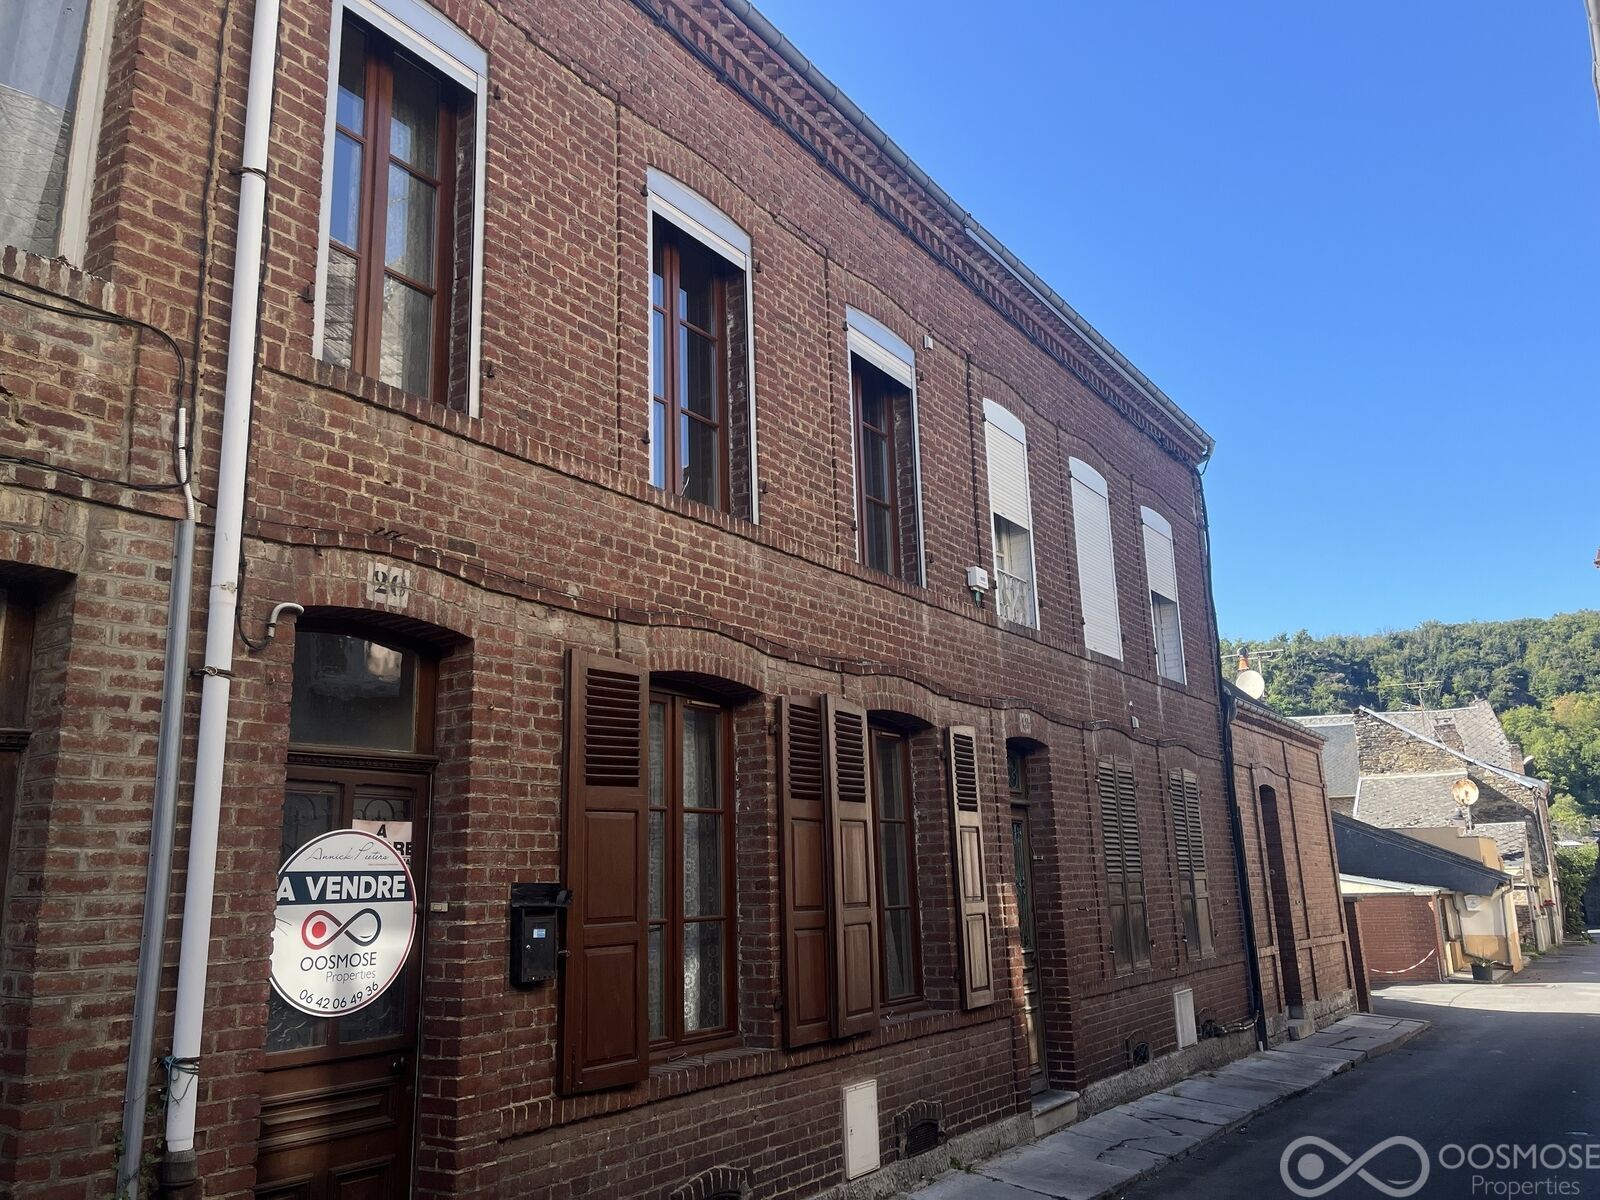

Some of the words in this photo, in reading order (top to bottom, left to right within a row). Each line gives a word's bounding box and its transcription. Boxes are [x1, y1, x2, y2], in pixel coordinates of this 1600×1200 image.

[376, 824, 388, 839] A
[305, 847, 353, 861] Annick
[276, 876, 296, 902] A
[305, 875, 406, 901] VENDRE
[300, 952, 377, 971] OOSMOSE
[326, 970, 376, 984] Properties
[299, 989, 314, 1004] 06
[316, 997, 330, 1009] 42
[332, 997, 347, 1009] 06
[350, 991, 363, 1004] 49
[365, 982, 379, 996] 36
